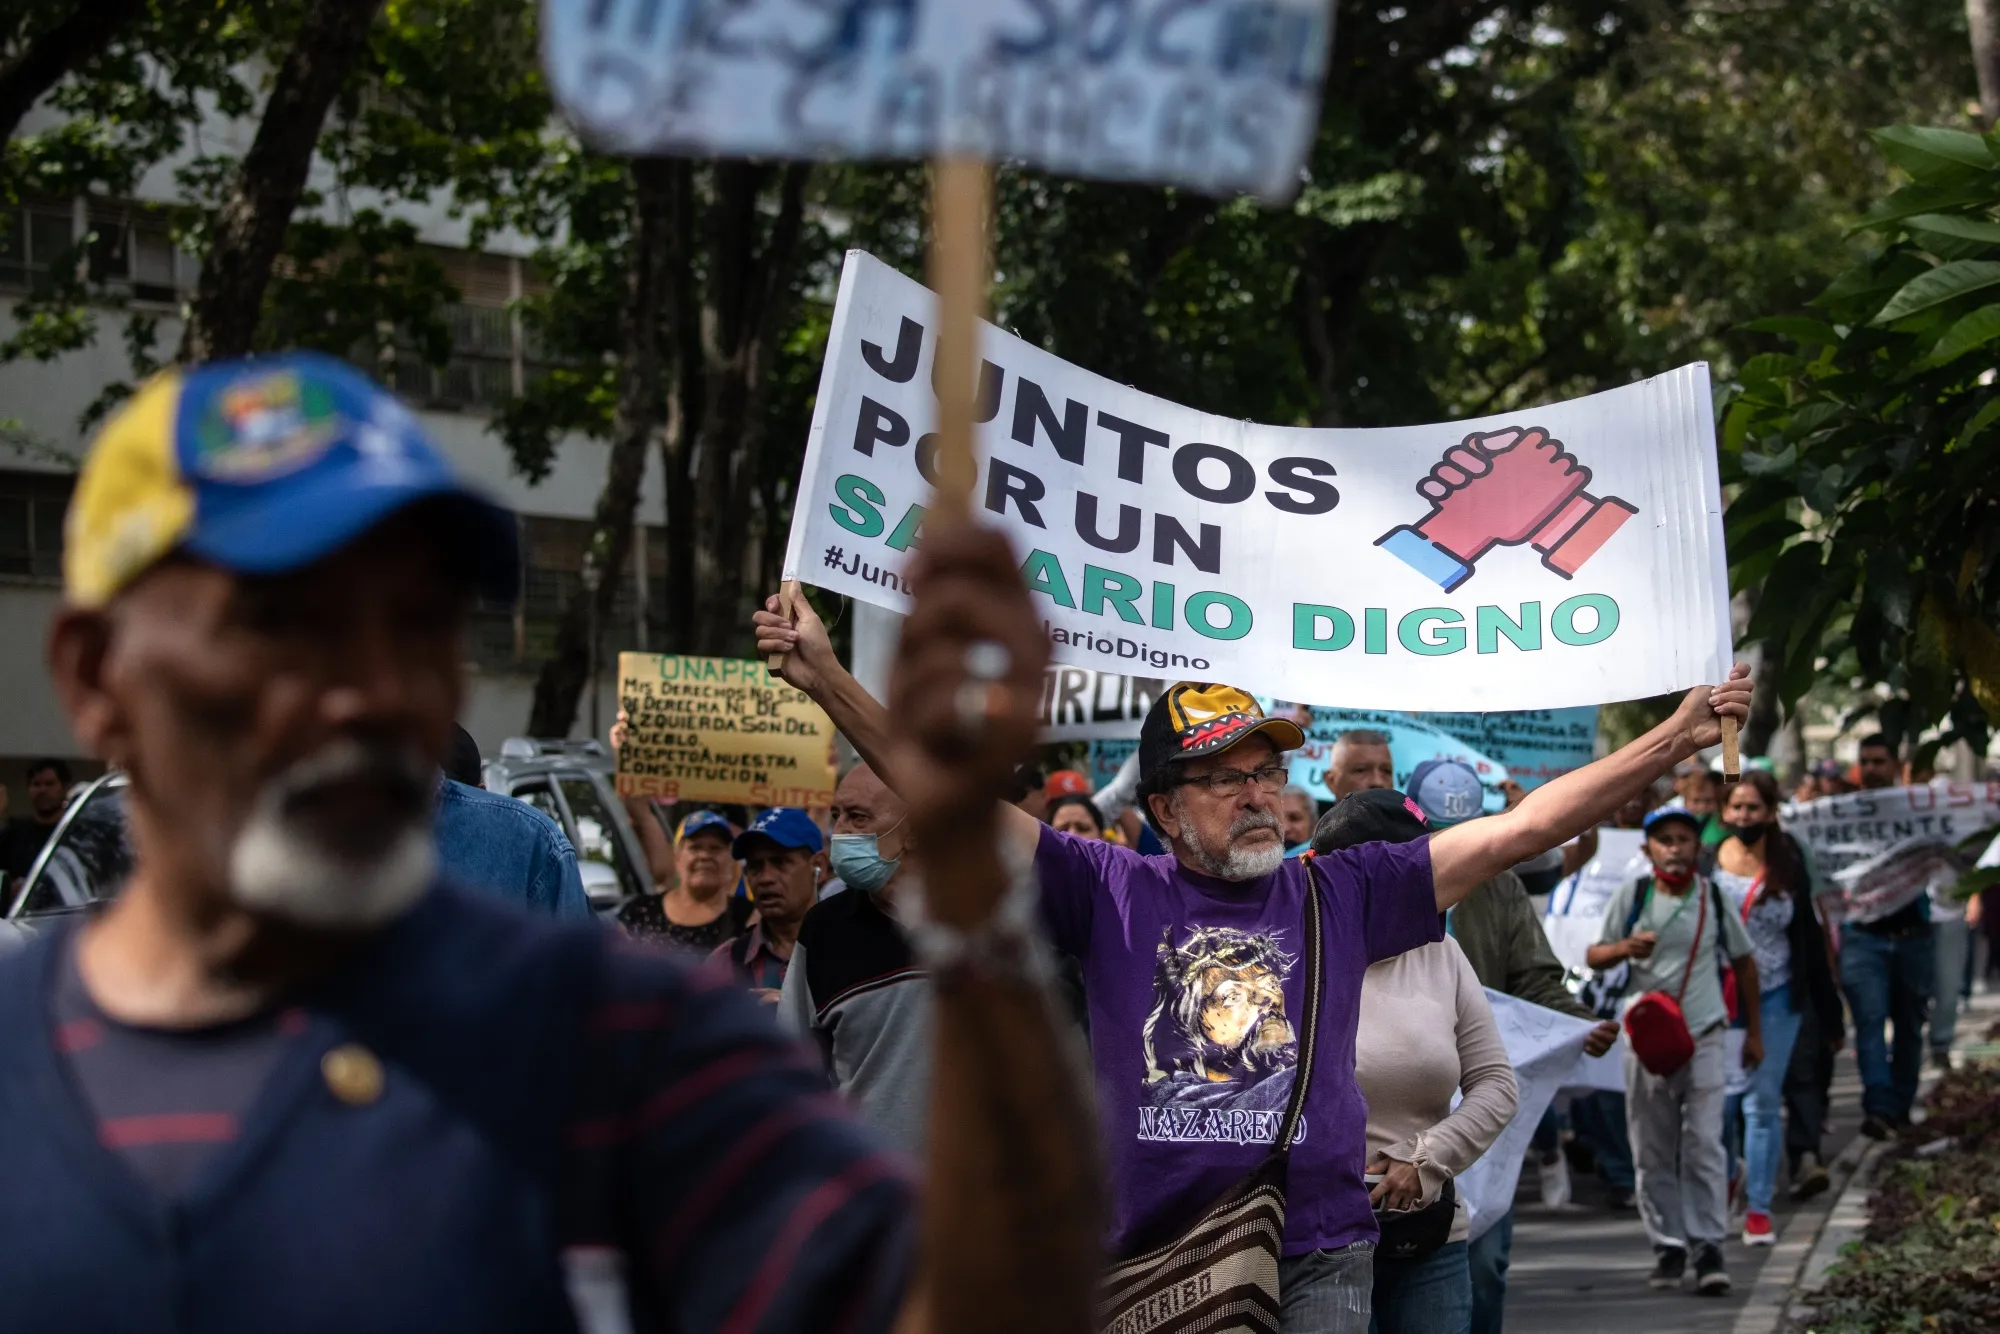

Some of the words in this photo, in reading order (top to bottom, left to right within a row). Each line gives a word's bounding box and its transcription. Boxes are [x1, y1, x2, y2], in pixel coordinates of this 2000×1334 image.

[1074, 490, 1221, 574] UN
[829, 474, 1253, 640] SAARIO
[1293, 593, 1620, 656] DIGNO
[661, 681, 746, 700] DERECHOS
[750, 687, 773, 703] NO
[778, 688, 815, 704] SO
[644, 695, 720, 713] DERECHA
[756, 699, 781, 717] DE
[740, 716, 781, 734] SON
[785, 717, 819, 736] DEL
[714, 752, 797, 769] NUESTRA
[1444, 791, 1472, 818] DC
[1807, 815, 1954, 844] PRESENTE
